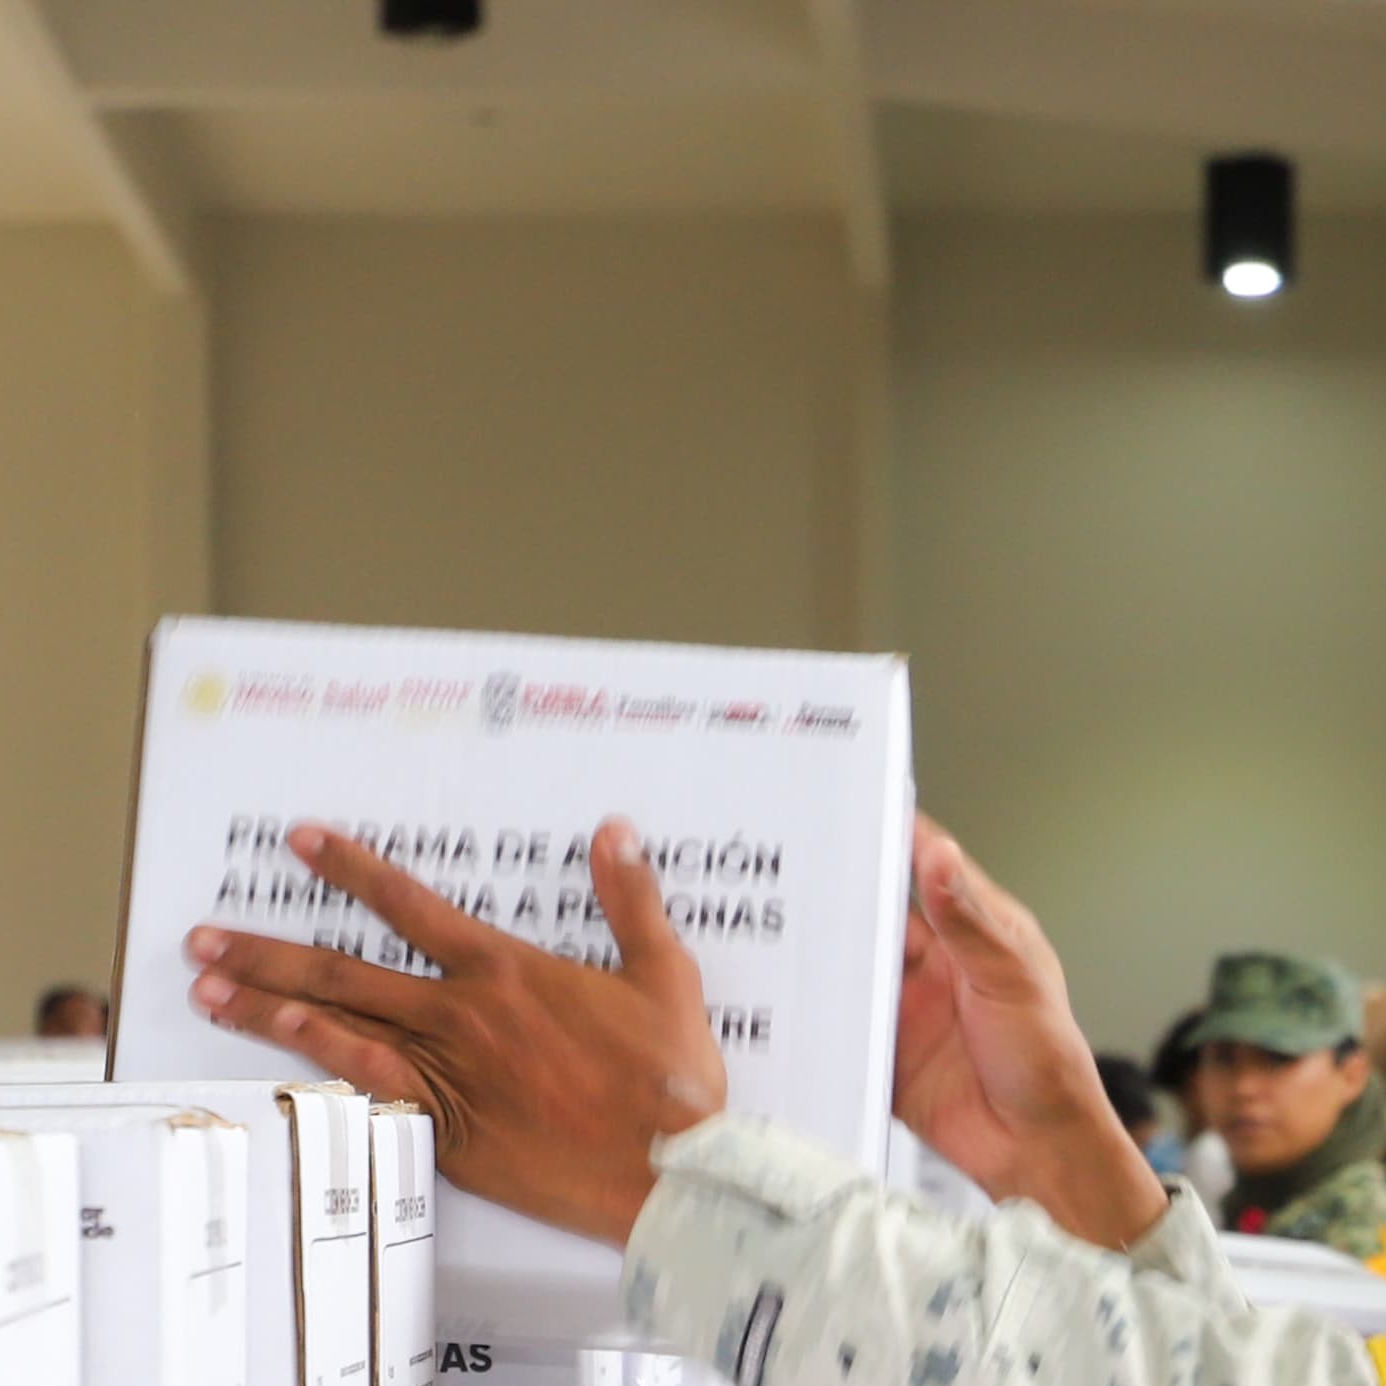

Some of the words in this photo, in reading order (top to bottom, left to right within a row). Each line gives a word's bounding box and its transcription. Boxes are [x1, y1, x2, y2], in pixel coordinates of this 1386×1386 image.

[494, 830, 551, 876] DE
[562, 830, 784, 884] ANCIÓN
[514, 887, 542, 928] A
[555, 889, 786, 940] PEONAS
[435, 1341, 493, 1374] AS
